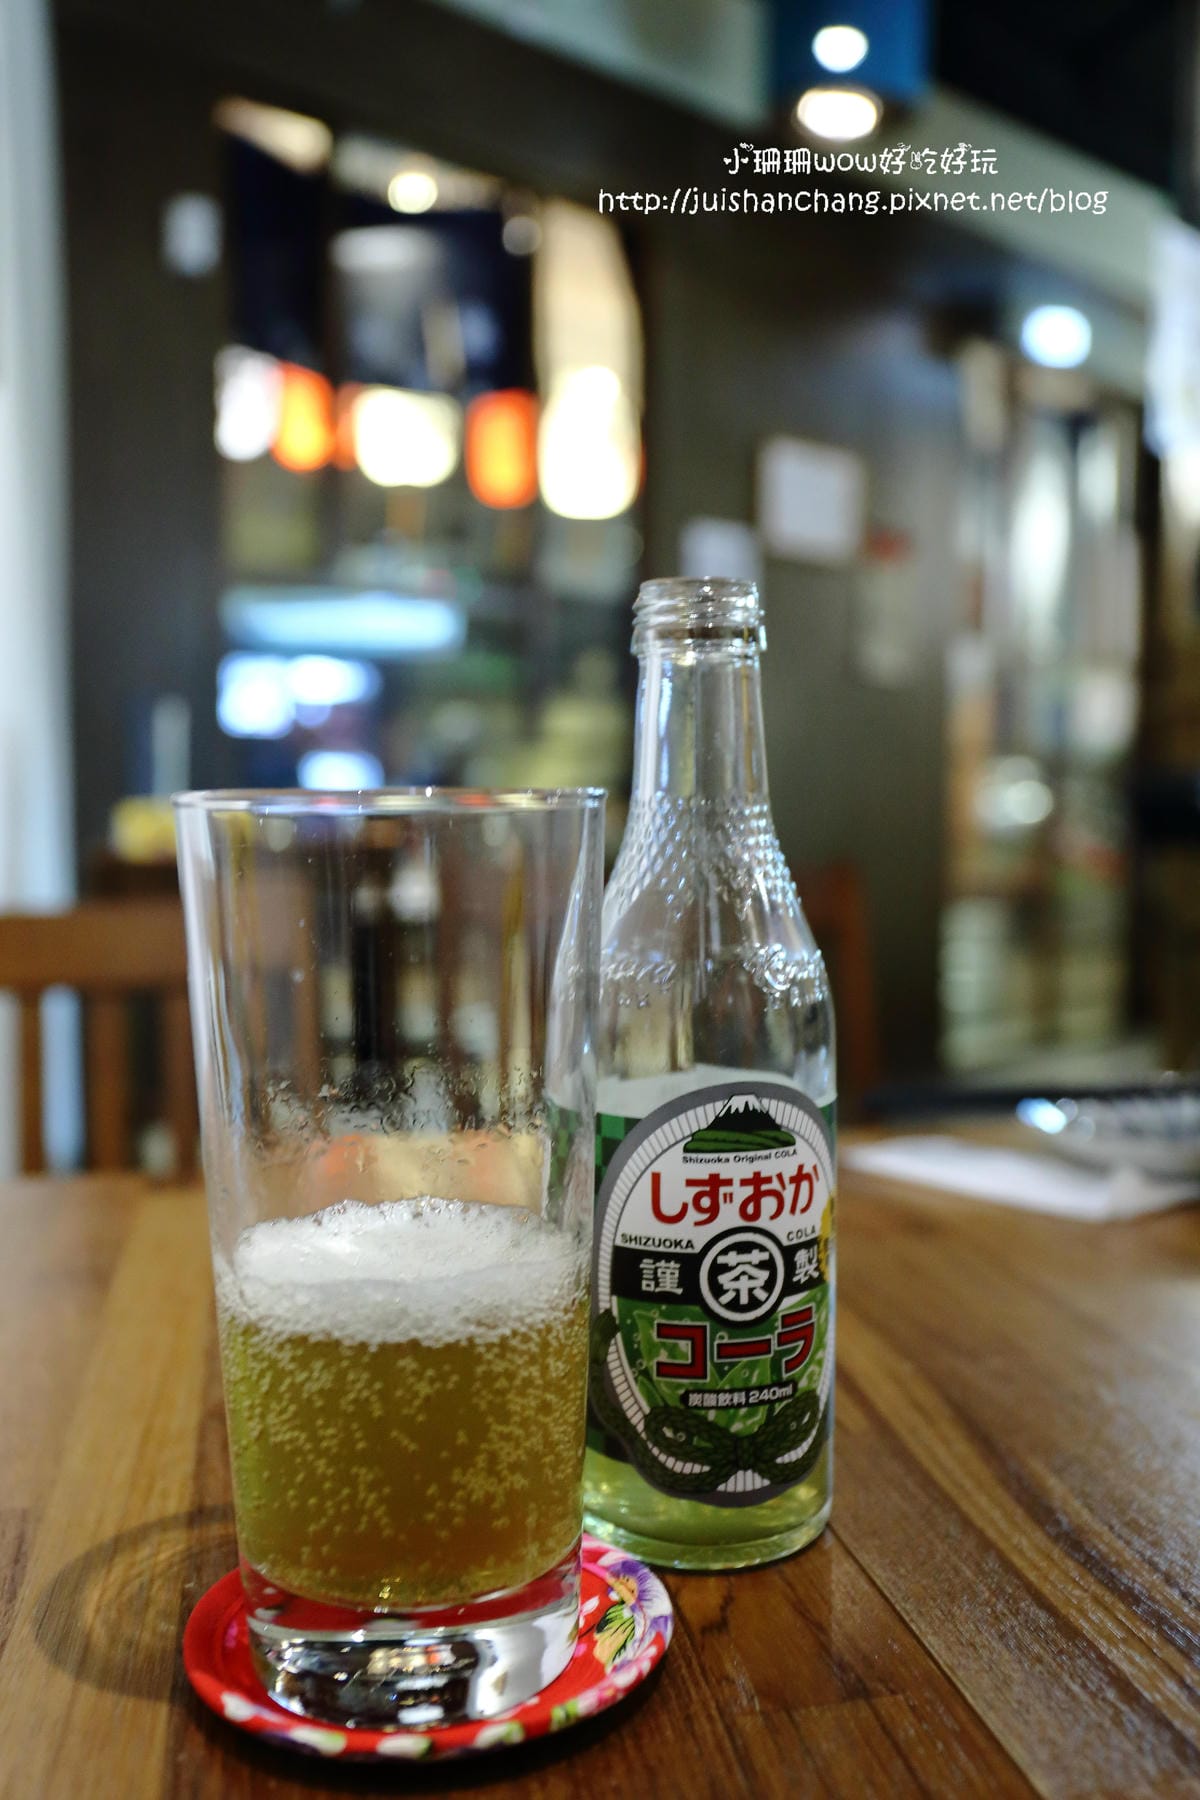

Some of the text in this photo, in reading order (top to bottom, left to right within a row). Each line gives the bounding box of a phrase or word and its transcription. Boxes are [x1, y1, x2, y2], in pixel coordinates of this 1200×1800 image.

[682, 1149, 797, 1164] Shizuoka Original COLA
[651, 1164, 820, 1227] しずおか
[620, 1225, 816, 1250] SHIZUOKA COLA
[654, 1302, 816, 1381] コーラ
